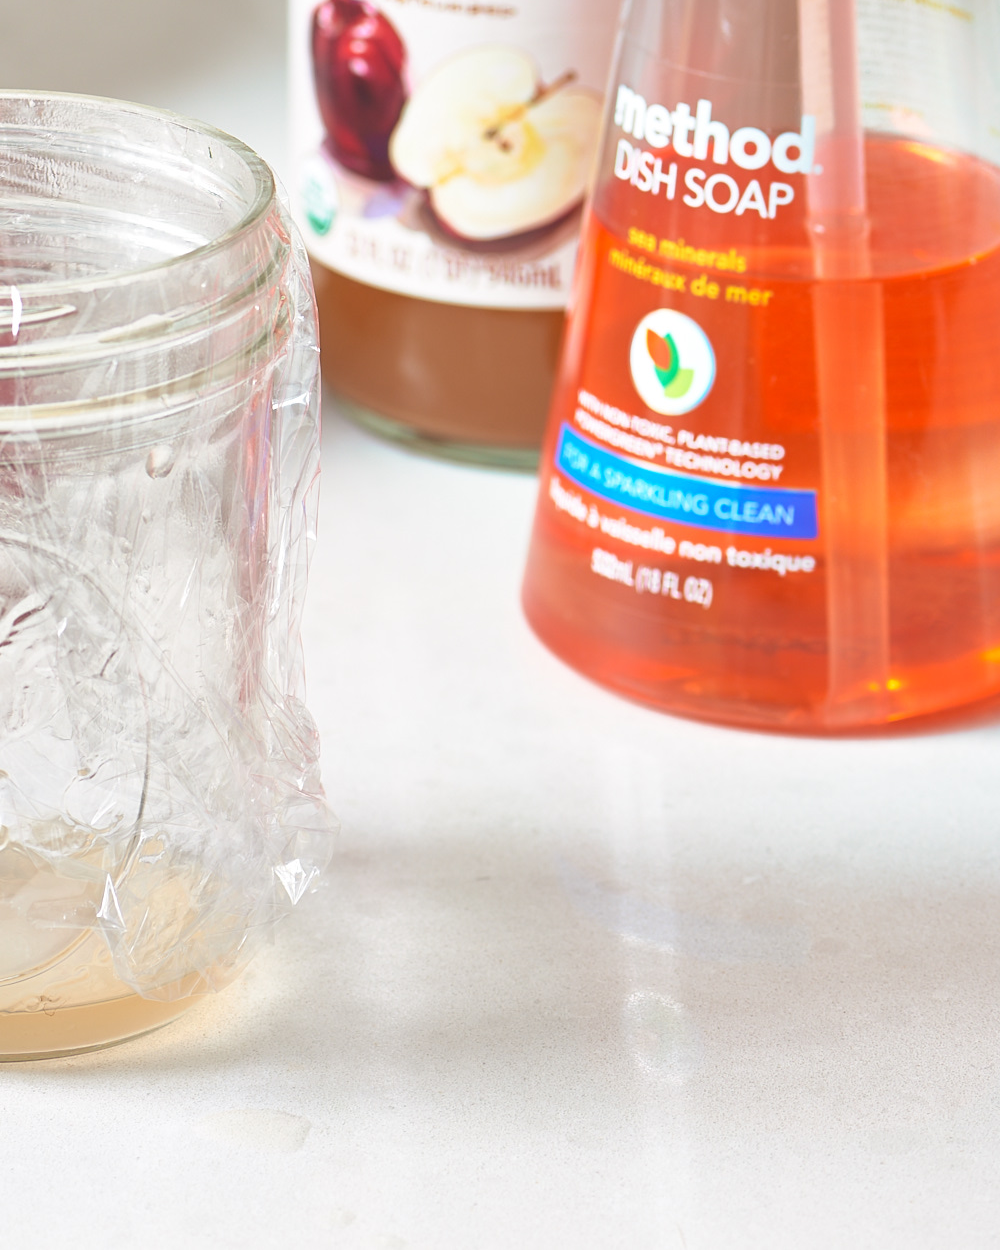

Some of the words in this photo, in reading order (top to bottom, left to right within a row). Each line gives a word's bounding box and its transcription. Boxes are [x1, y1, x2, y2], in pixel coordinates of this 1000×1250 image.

[614, 138, 678, 200] DISH
[682, 167, 795, 220] SOAP
[628, 226, 657, 252] sea
[658, 237, 747, 274] minerals
[690, 273, 720, 300] de
[725, 284, 774, 307] mer
[563, 441, 590, 472] FOR
[589, 461, 602, 480] A
[603, 466, 710, 517] SPARKLING
[713, 497, 796, 527] CLEAN
[664, 445, 784, 481] TECHNOLOGY
[678, 539, 723, 565] non
[725, 545, 817, 578] toxique
